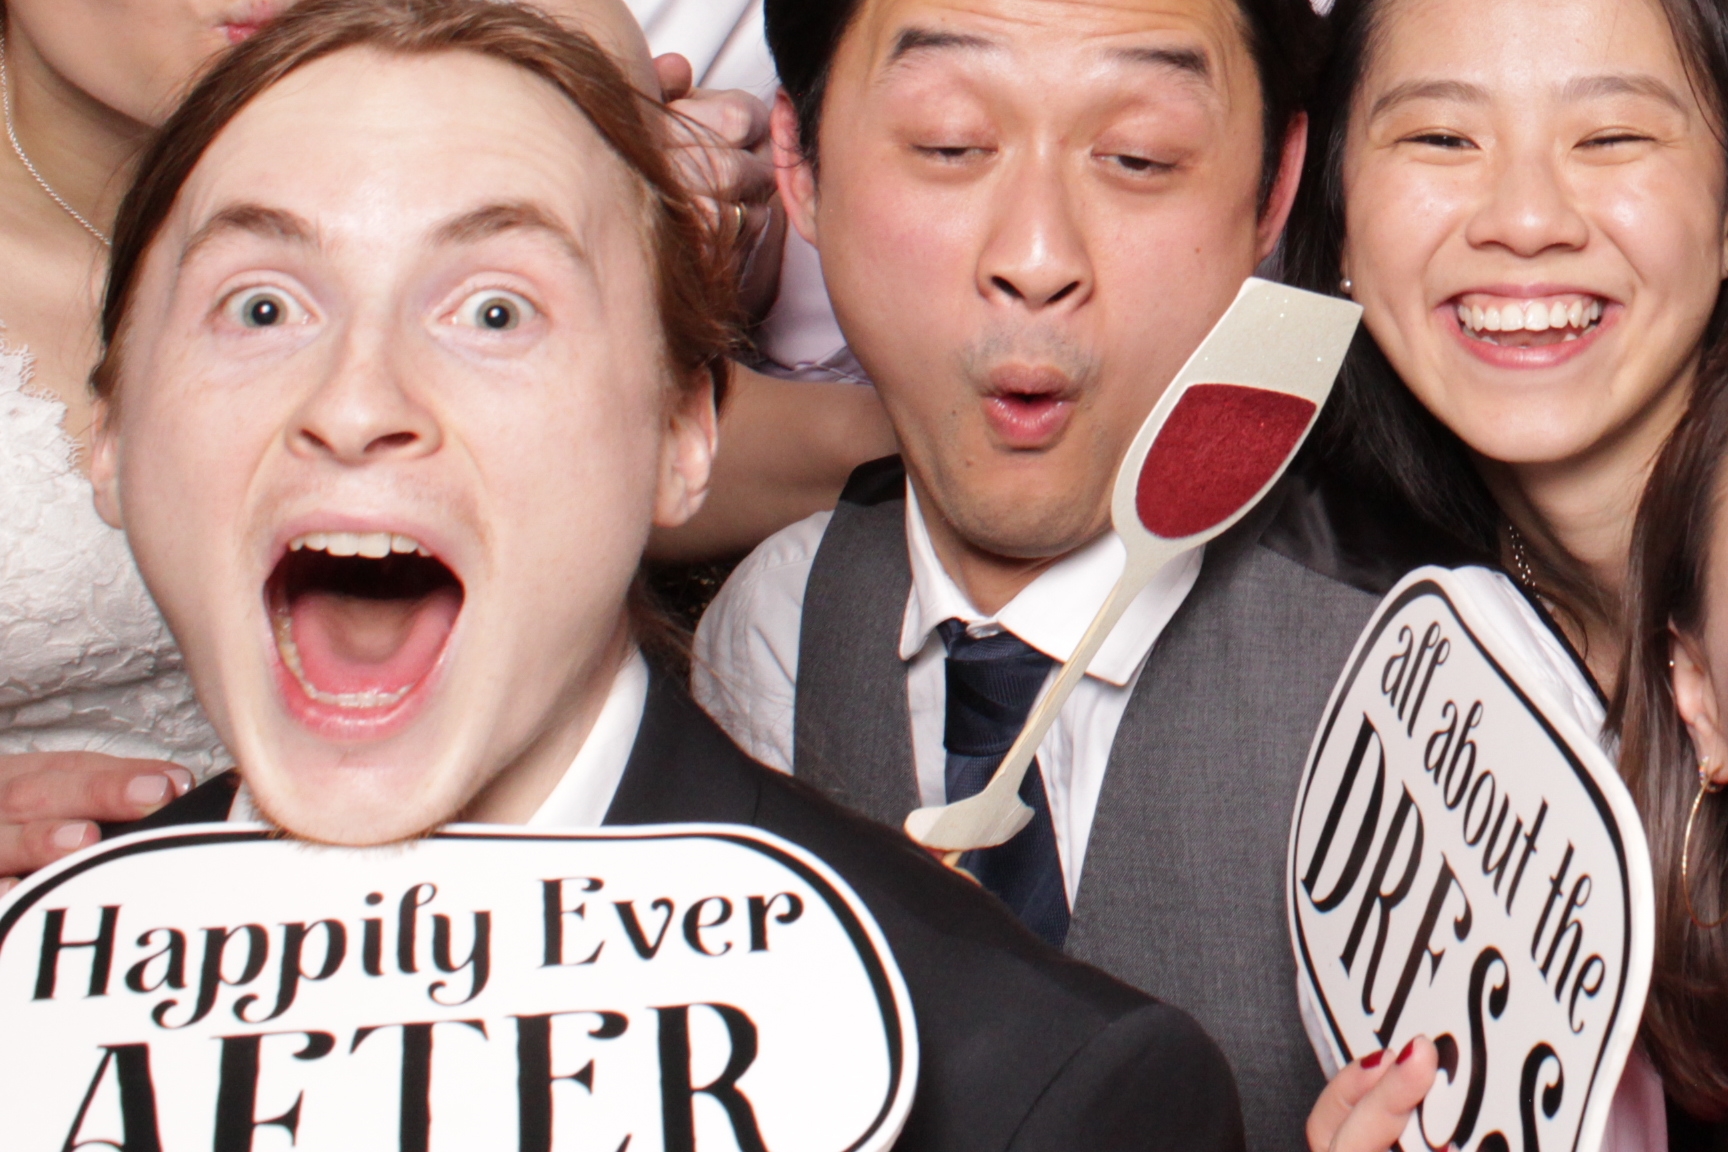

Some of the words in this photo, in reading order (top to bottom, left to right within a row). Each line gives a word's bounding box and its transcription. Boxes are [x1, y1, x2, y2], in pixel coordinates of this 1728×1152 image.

[1380, 621, 1451, 737] all
[1424, 700, 1548, 916] about
[1530, 839, 1606, 1034] the
[30, 883, 493, 1029] Happily
[537, 877, 805, 969] Ever
[61, 1002, 769, 1152] AFTER
